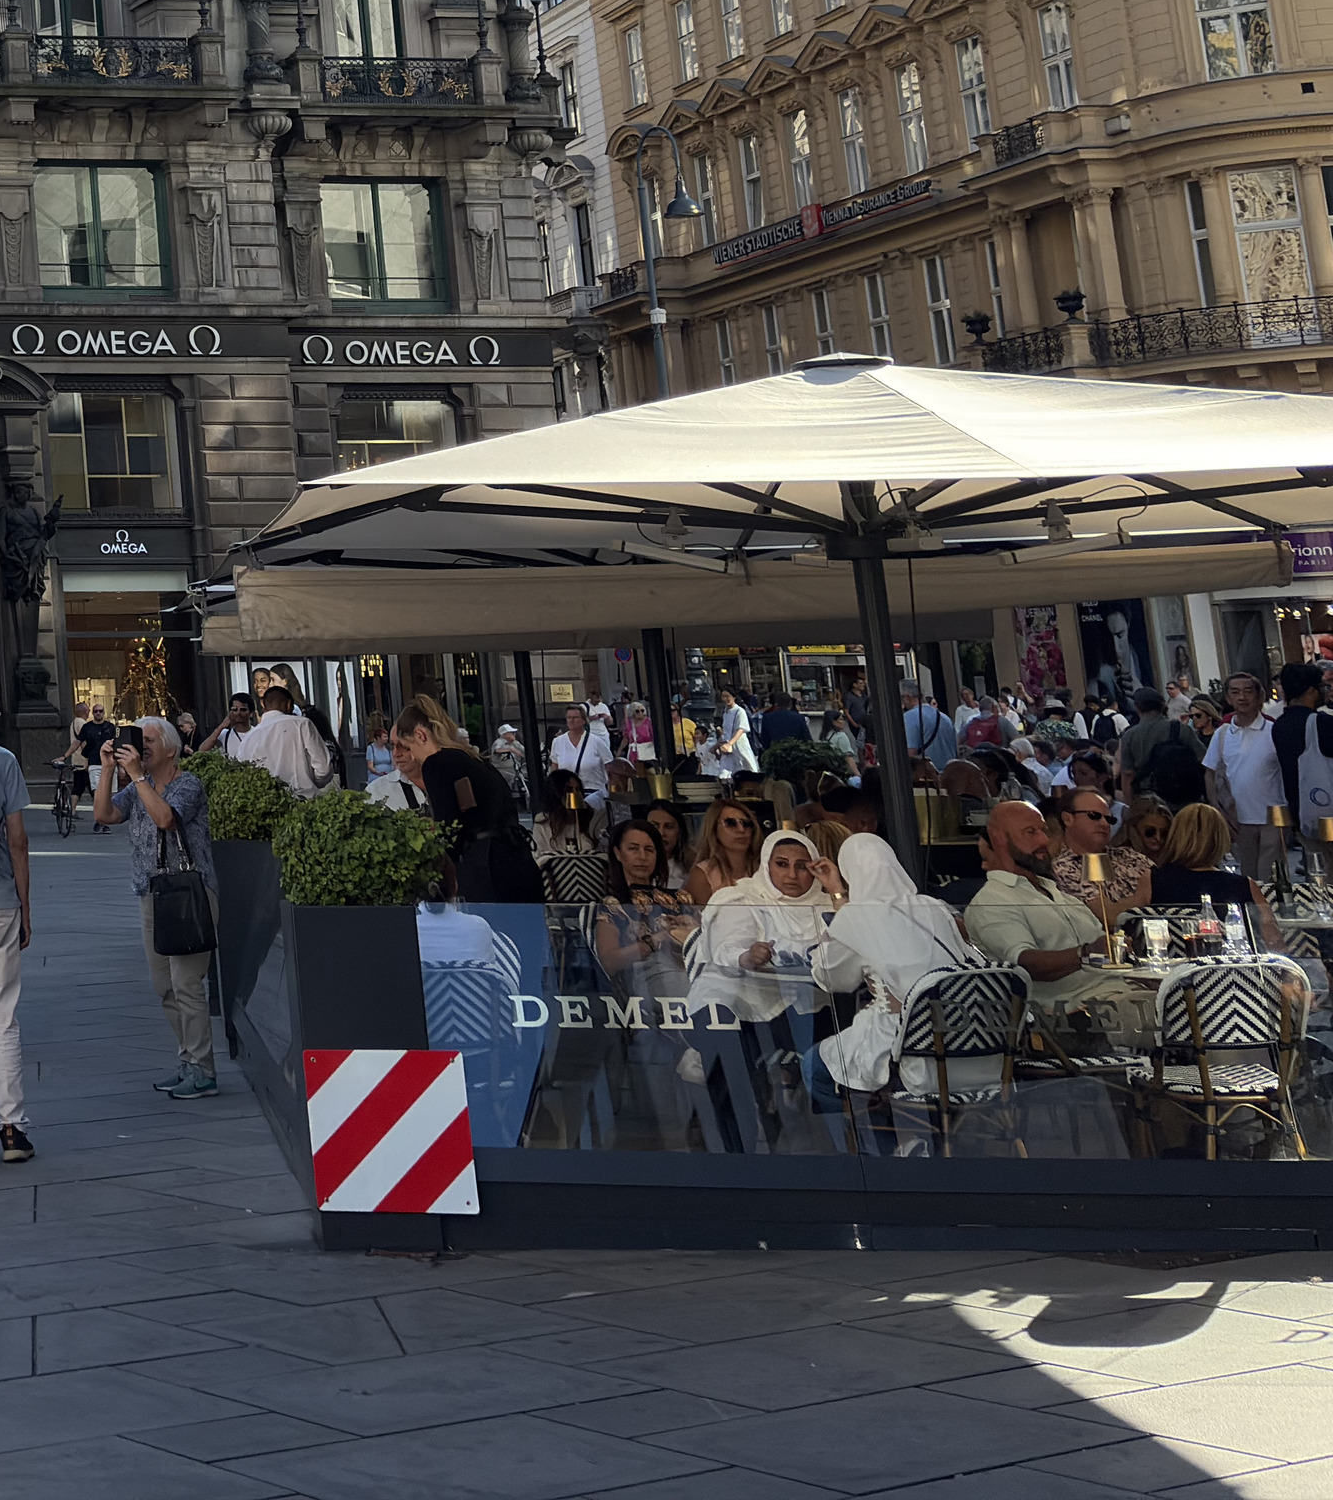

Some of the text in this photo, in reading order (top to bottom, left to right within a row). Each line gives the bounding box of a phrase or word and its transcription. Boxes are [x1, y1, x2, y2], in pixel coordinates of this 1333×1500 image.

[713, 241, 745, 265] WIENER
[57, 329, 179, 356] OMEGA
[344, 340, 459, 366] OMEGA
[100, 543, 148, 553] OMEGA
[1293, 544, 1333, 556] rionn
[508, 994, 741, 1031] DEMEL
